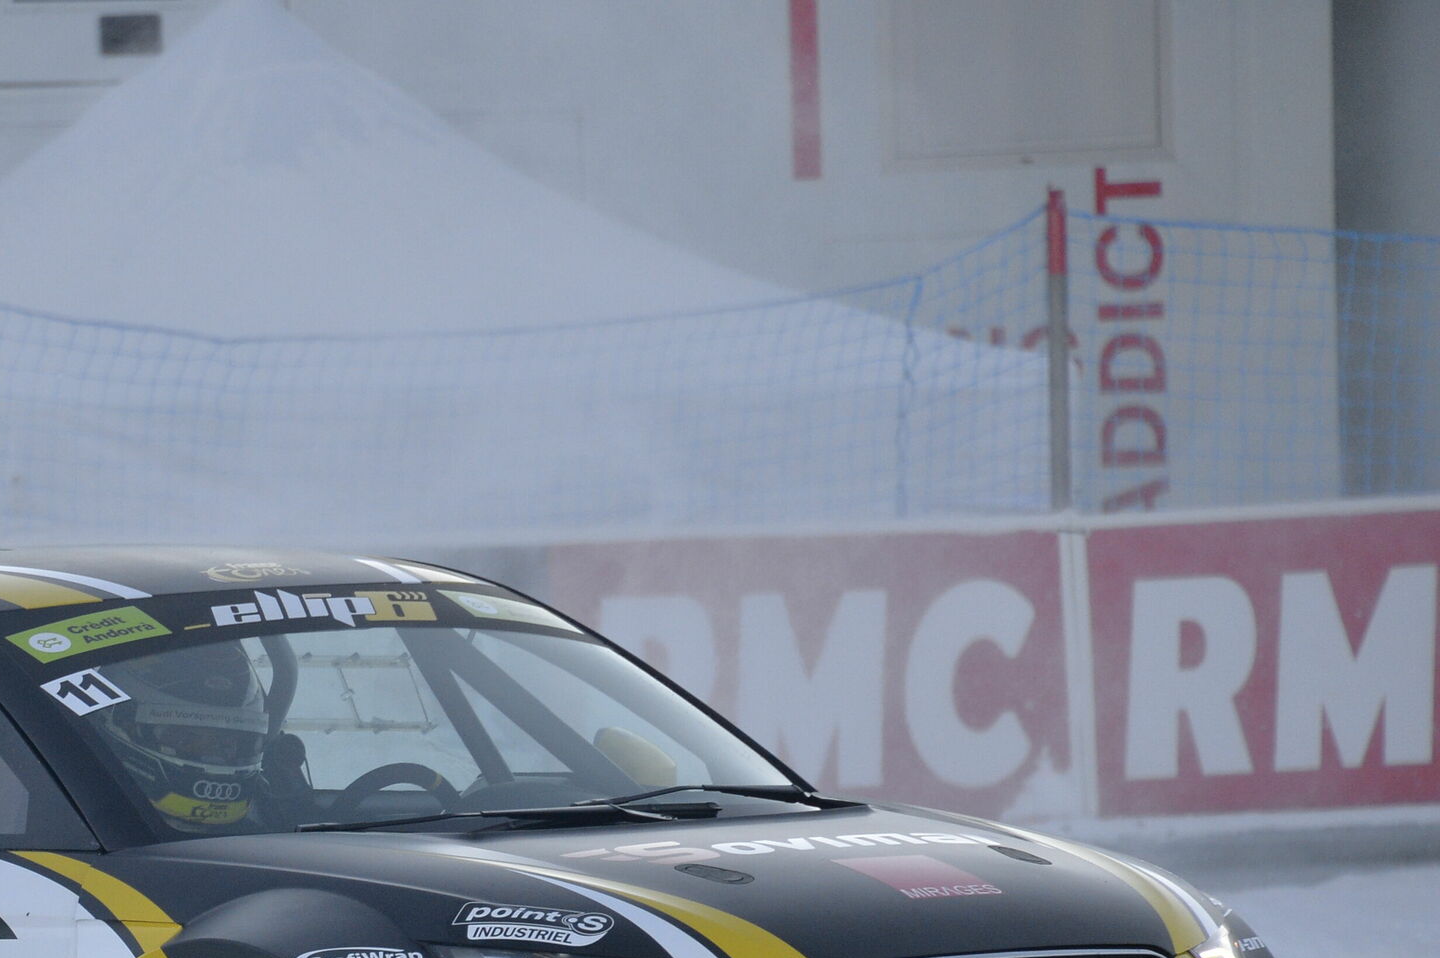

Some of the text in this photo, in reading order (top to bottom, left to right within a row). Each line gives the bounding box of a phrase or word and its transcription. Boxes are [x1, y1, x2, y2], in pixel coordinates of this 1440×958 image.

[66, 616, 124, 635] Crèdit
[82, 622, 155, 646] Andorrà
[56, 672, 121, 708] 11
[899, 884, 1002, 899] MIRAGES
[471, 925, 573, 945] INDUSTRIEL
